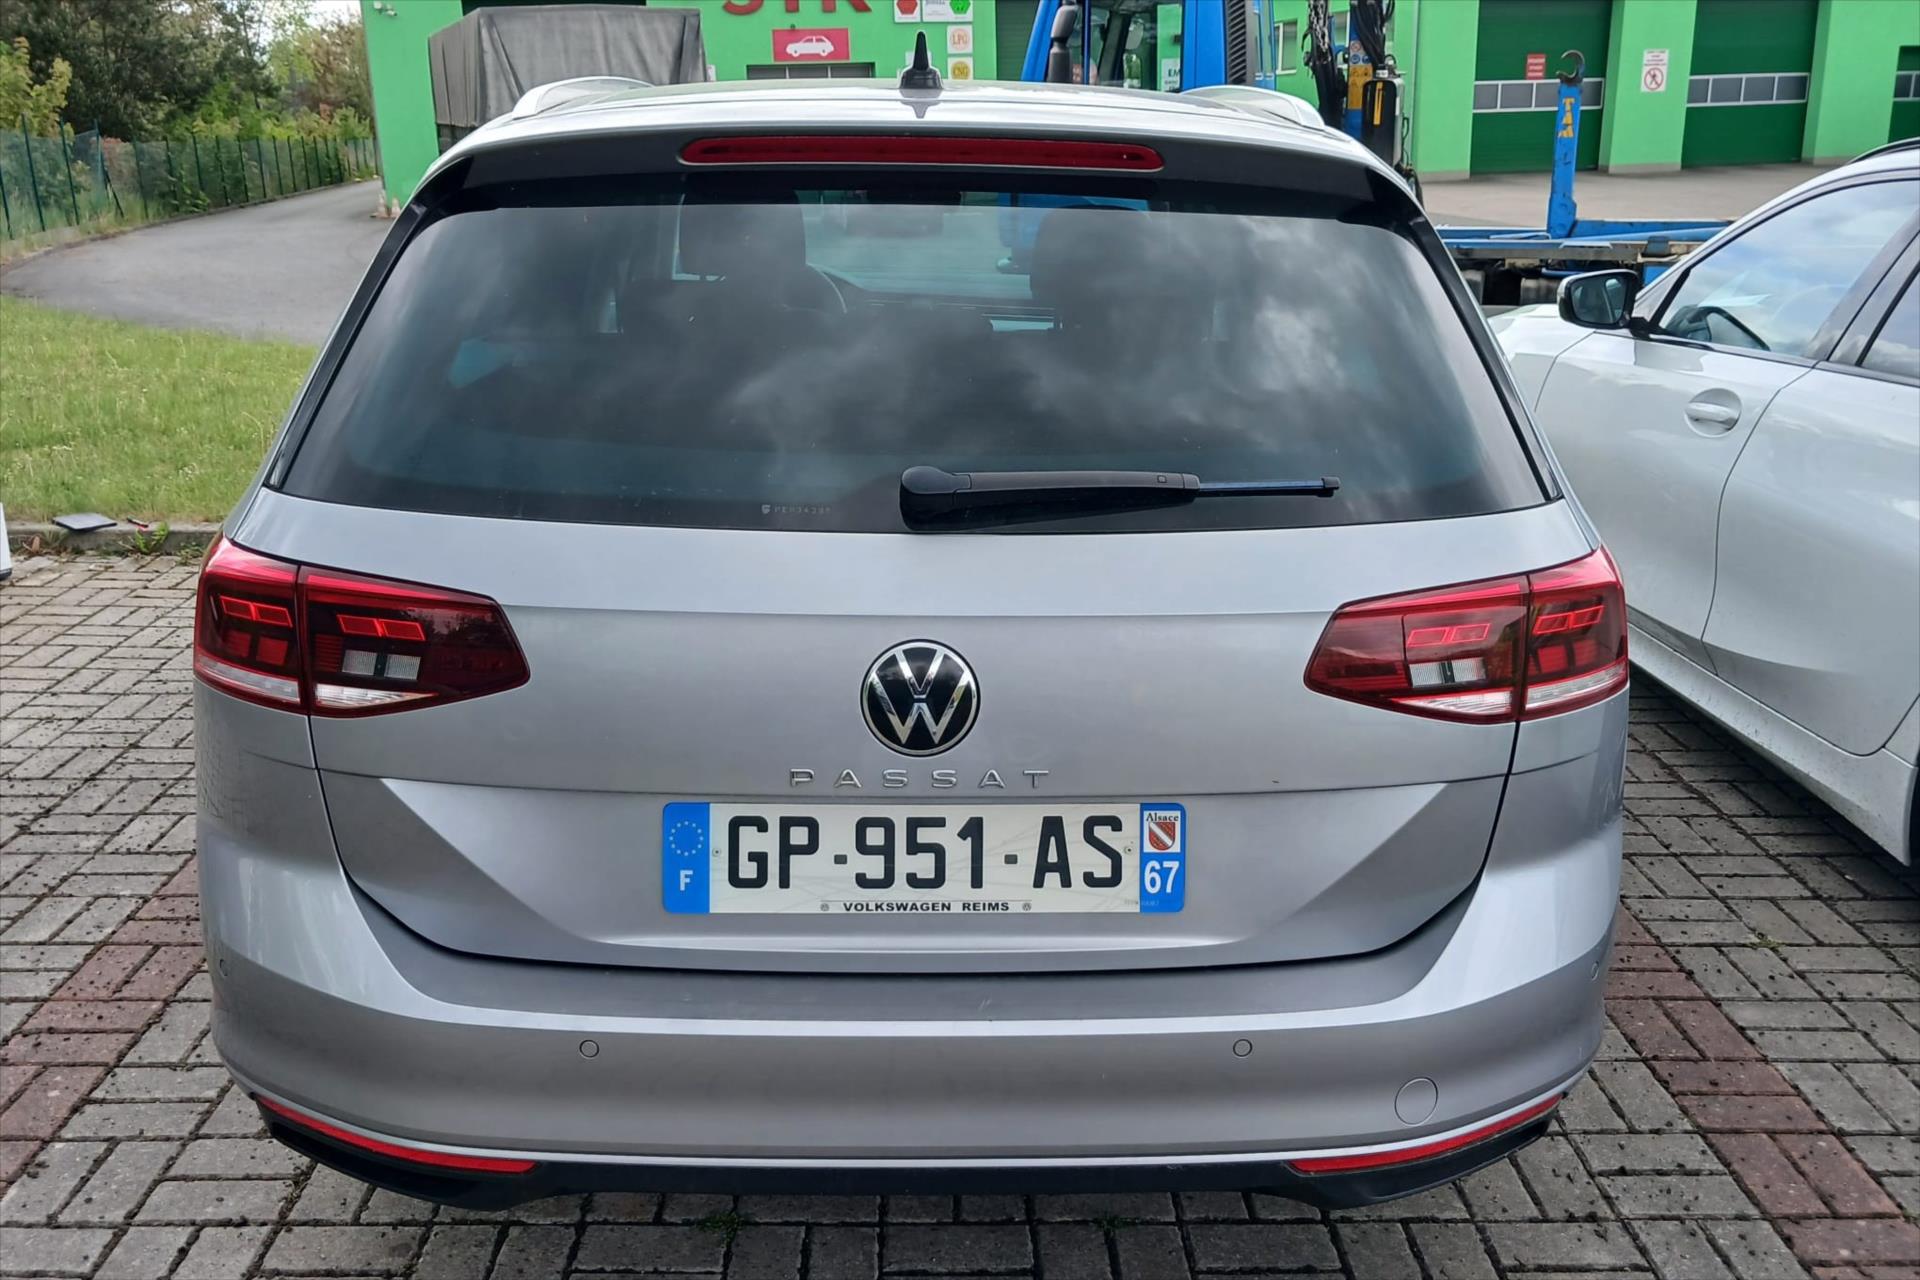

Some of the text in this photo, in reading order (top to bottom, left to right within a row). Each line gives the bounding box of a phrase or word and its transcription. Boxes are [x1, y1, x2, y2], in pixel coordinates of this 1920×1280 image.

[863, 641, 978, 756] VW
[789, 768, 1050, 789] PASSAT
[1145, 812, 1179, 822] Alsace
[679, 870, 693, 891] F
[1144, 860, 1180, 894] 67
[843, 902, 1010, 912] VOLKSWAGEN REIMS
